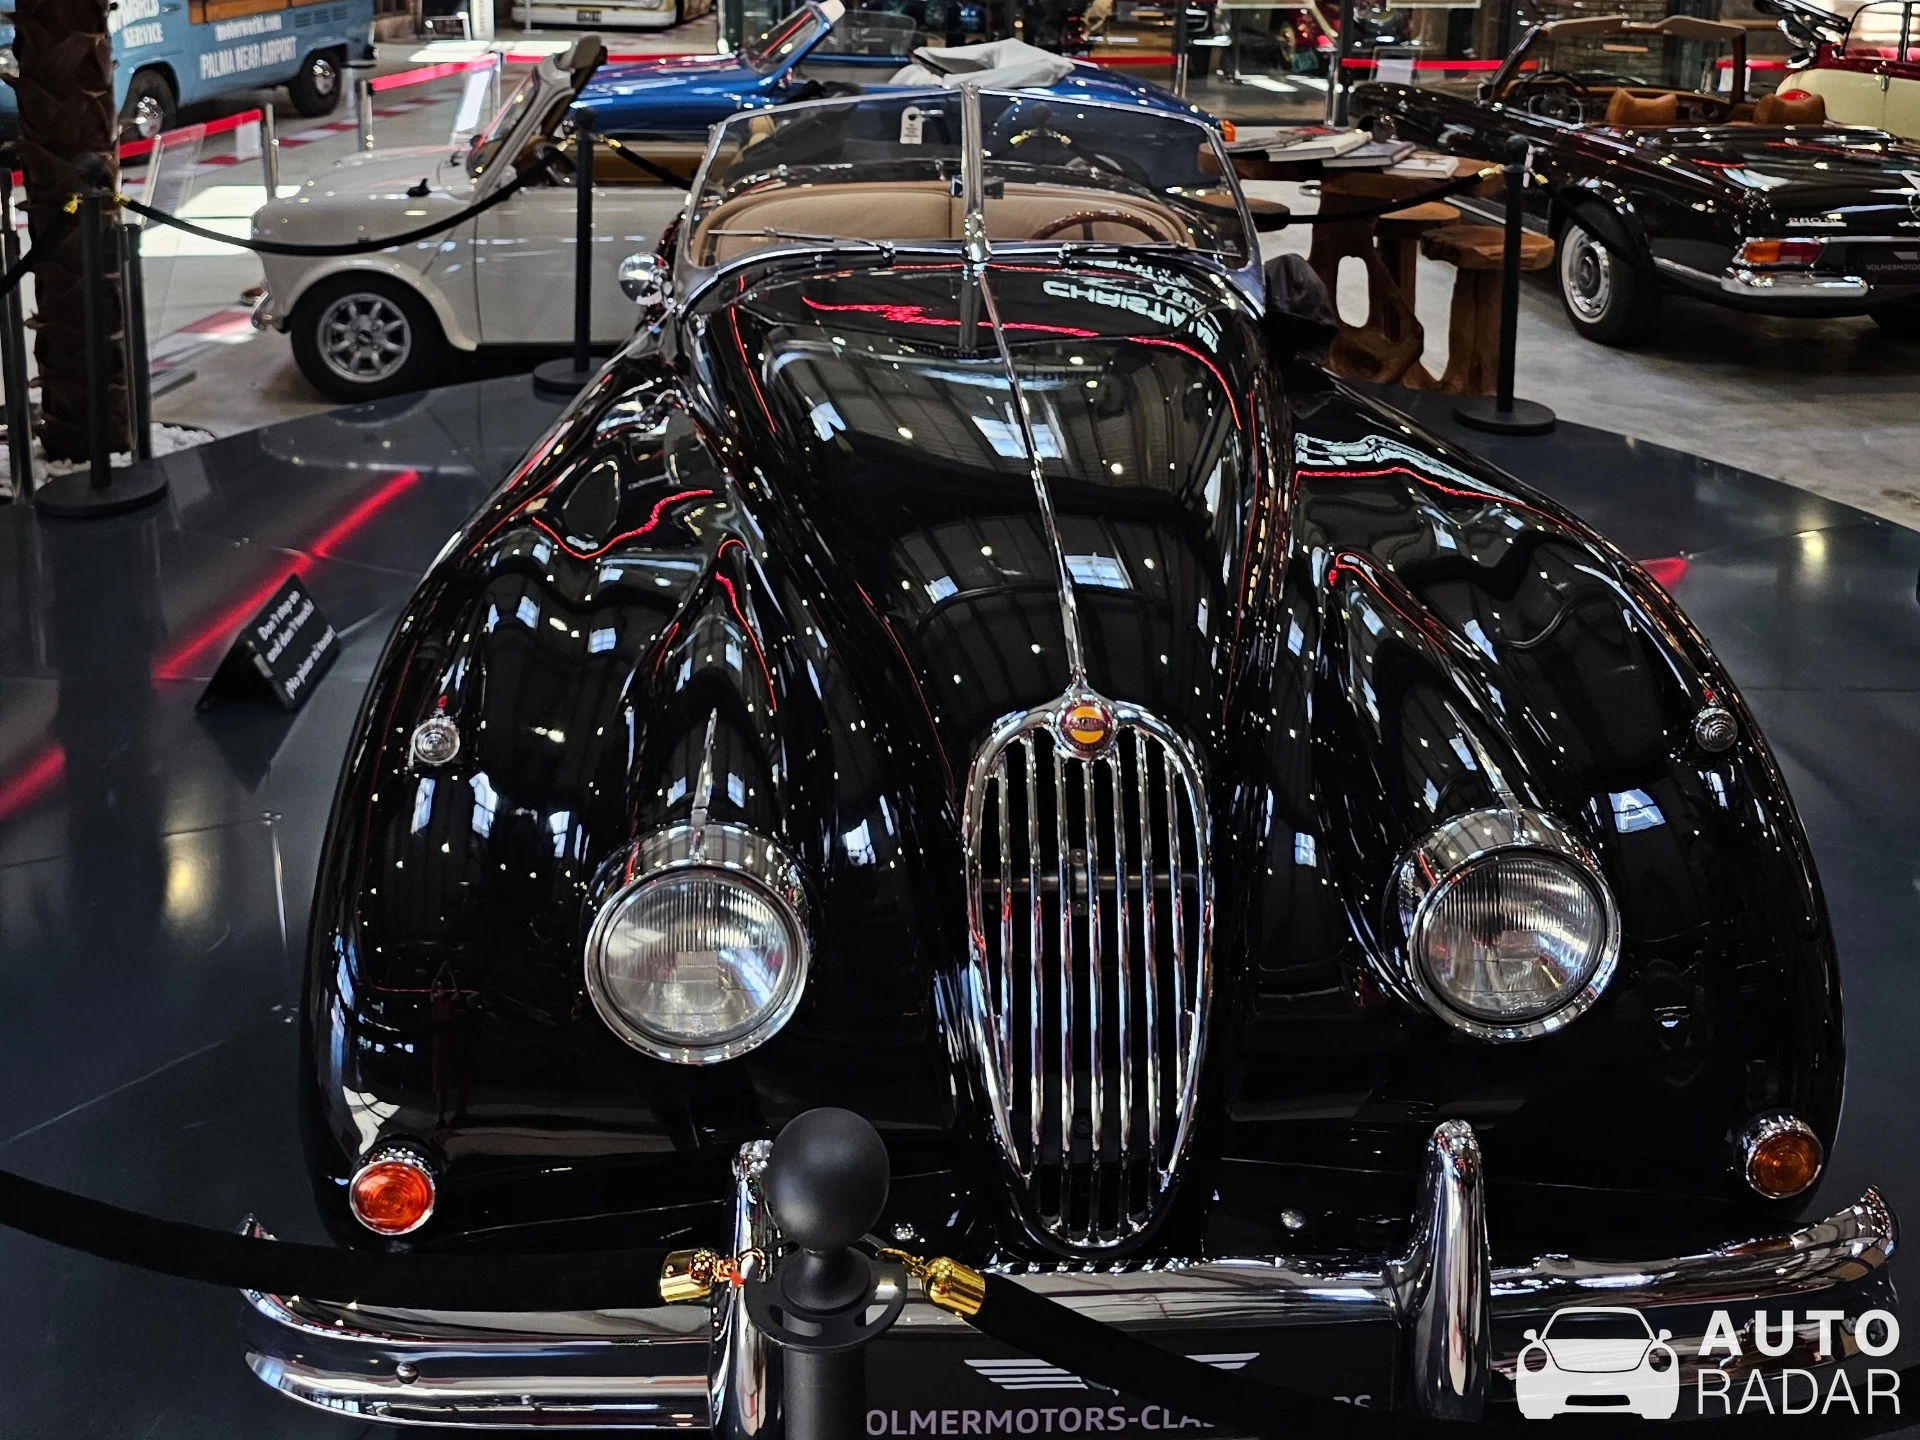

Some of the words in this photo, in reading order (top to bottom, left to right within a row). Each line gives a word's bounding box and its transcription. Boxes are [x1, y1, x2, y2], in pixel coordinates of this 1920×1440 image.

[122, 22, 163, 49] SERVICE
[200, 48, 236, 80] PALMA
[234, 43, 261, 72] NEAR
[260, 35, 297, 67] AIRPORT
[257, 612, 280, 641] Don't
[288, 590, 300, 605] on
